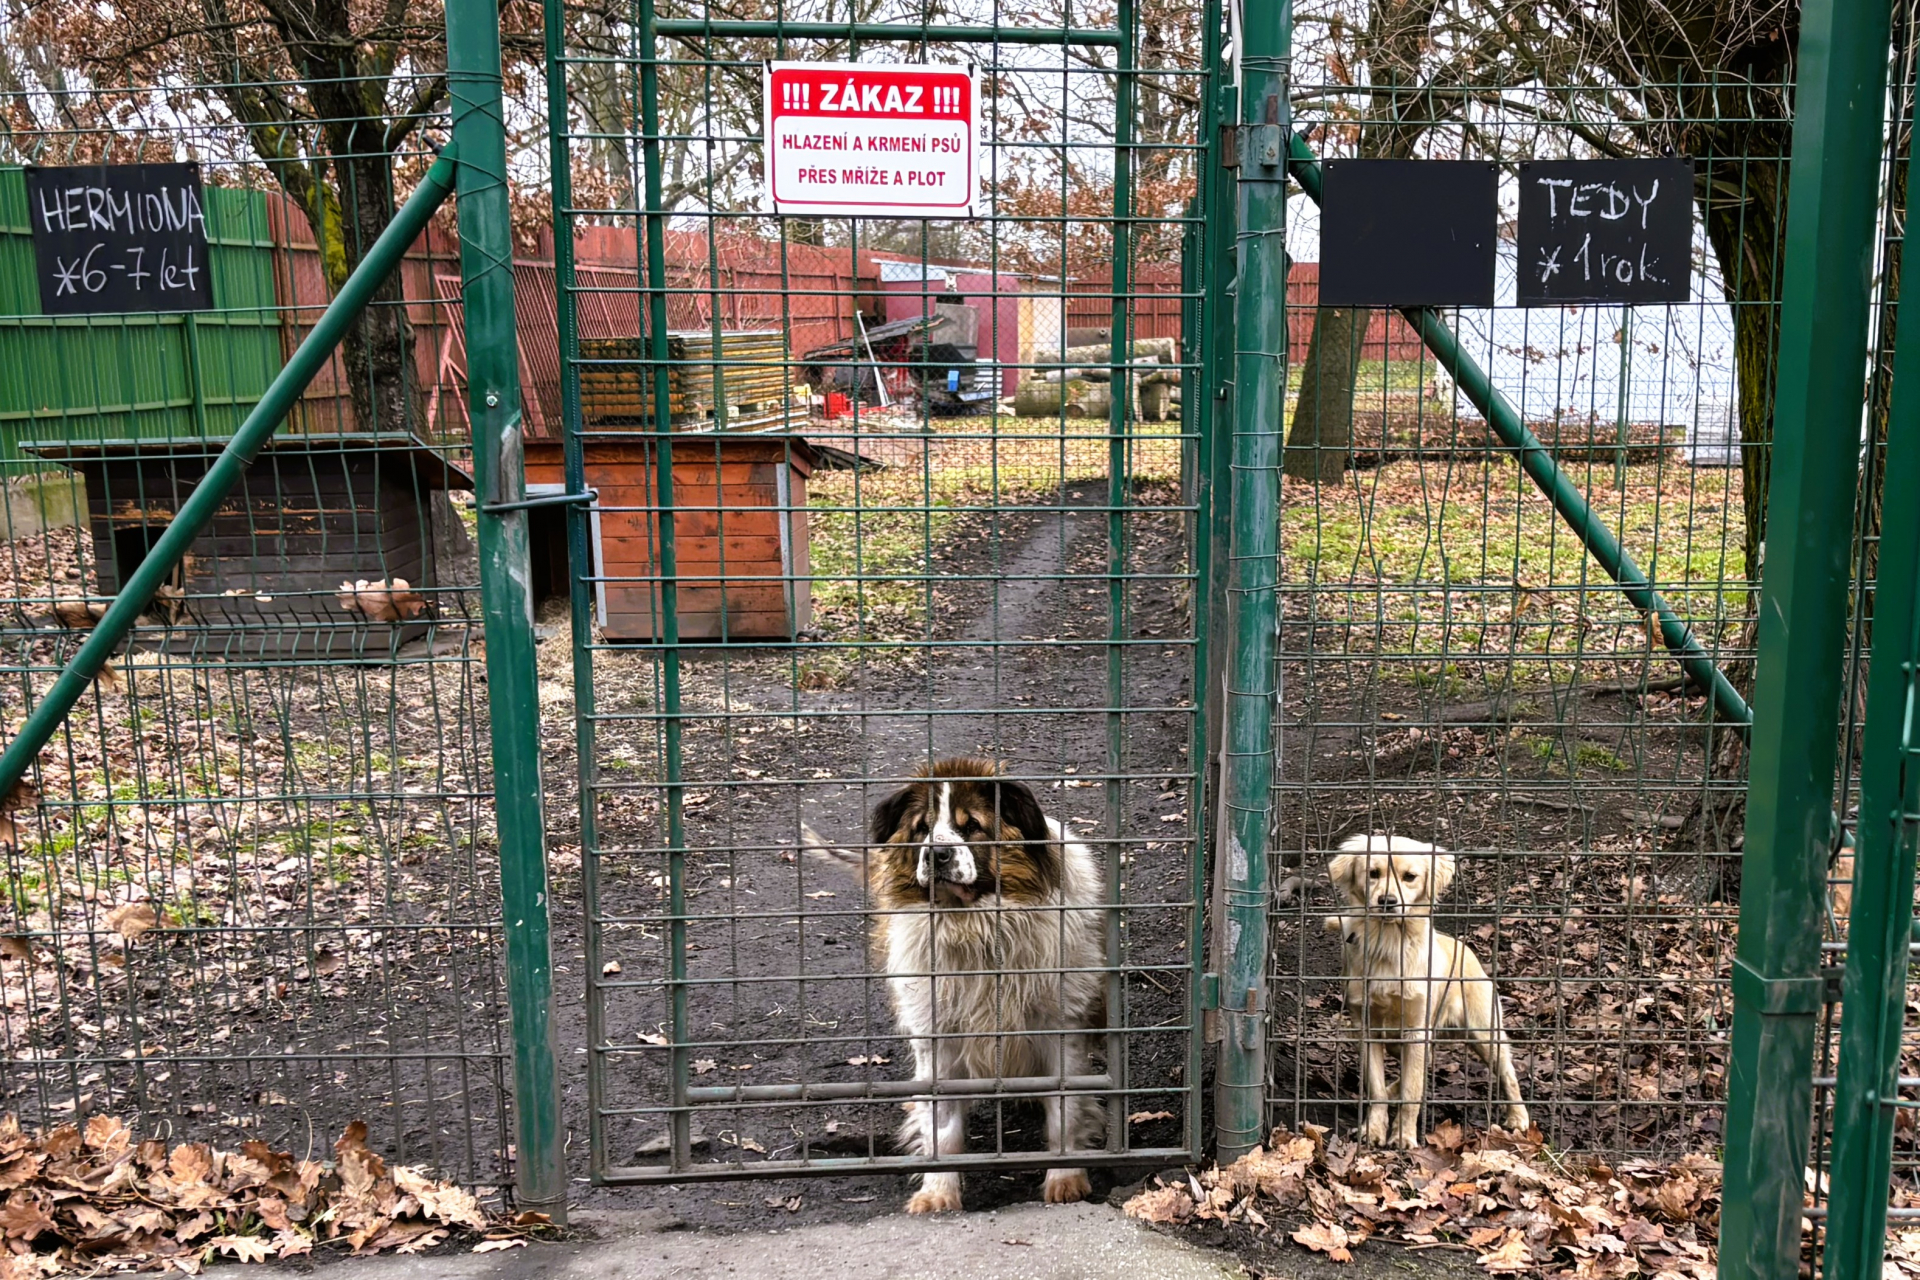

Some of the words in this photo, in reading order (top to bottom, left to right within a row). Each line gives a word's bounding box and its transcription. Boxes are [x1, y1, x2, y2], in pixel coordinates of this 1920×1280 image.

[782, 83, 810, 110] !!!
[819, 78, 924, 113] ZÁKAZ
[933, 86, 960, 114] !!!
[782, 132, 848, 150] HLAZENÍ
[852, 136, 863, 151] A
[867, 134, 927, 152] KRMENÍ
[931, 133, 961, 153] PSŮ
[798, 165, 837, 184] PŘES
[842, 166, 889, 185] MŘÍŽE
[893, 171, 904, 185] A
[908, 171, 946, 186] PLOT
[39, 184, 208, 240] HERMIONA
[1537, 178, 1660, 230] TEDY
[159, 244, 200, 291] let
[1600, 242, 1669, 284] rok
